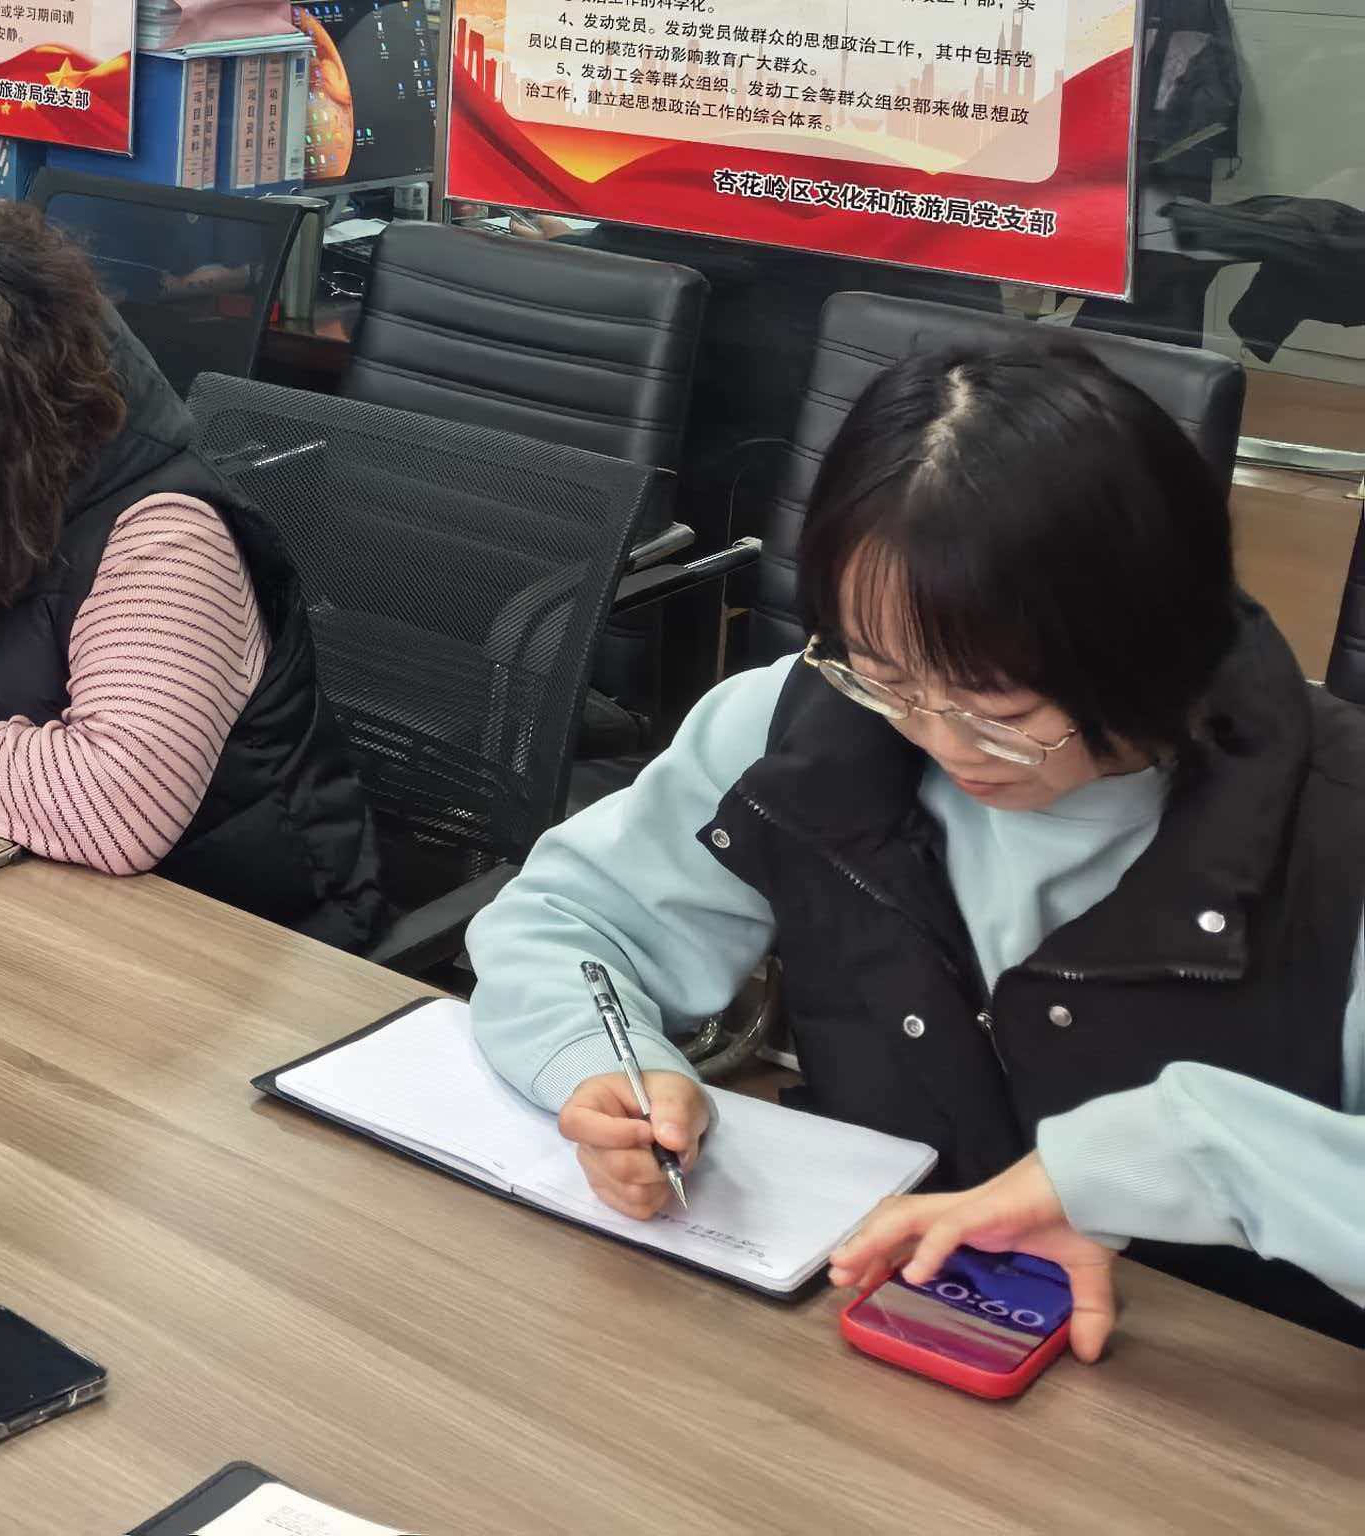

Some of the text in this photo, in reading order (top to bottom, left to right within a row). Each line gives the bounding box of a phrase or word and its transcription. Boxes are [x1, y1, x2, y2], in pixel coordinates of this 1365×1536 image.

[711, 166, 1057, 239] 杏花岭区文化和旅游局党支部
